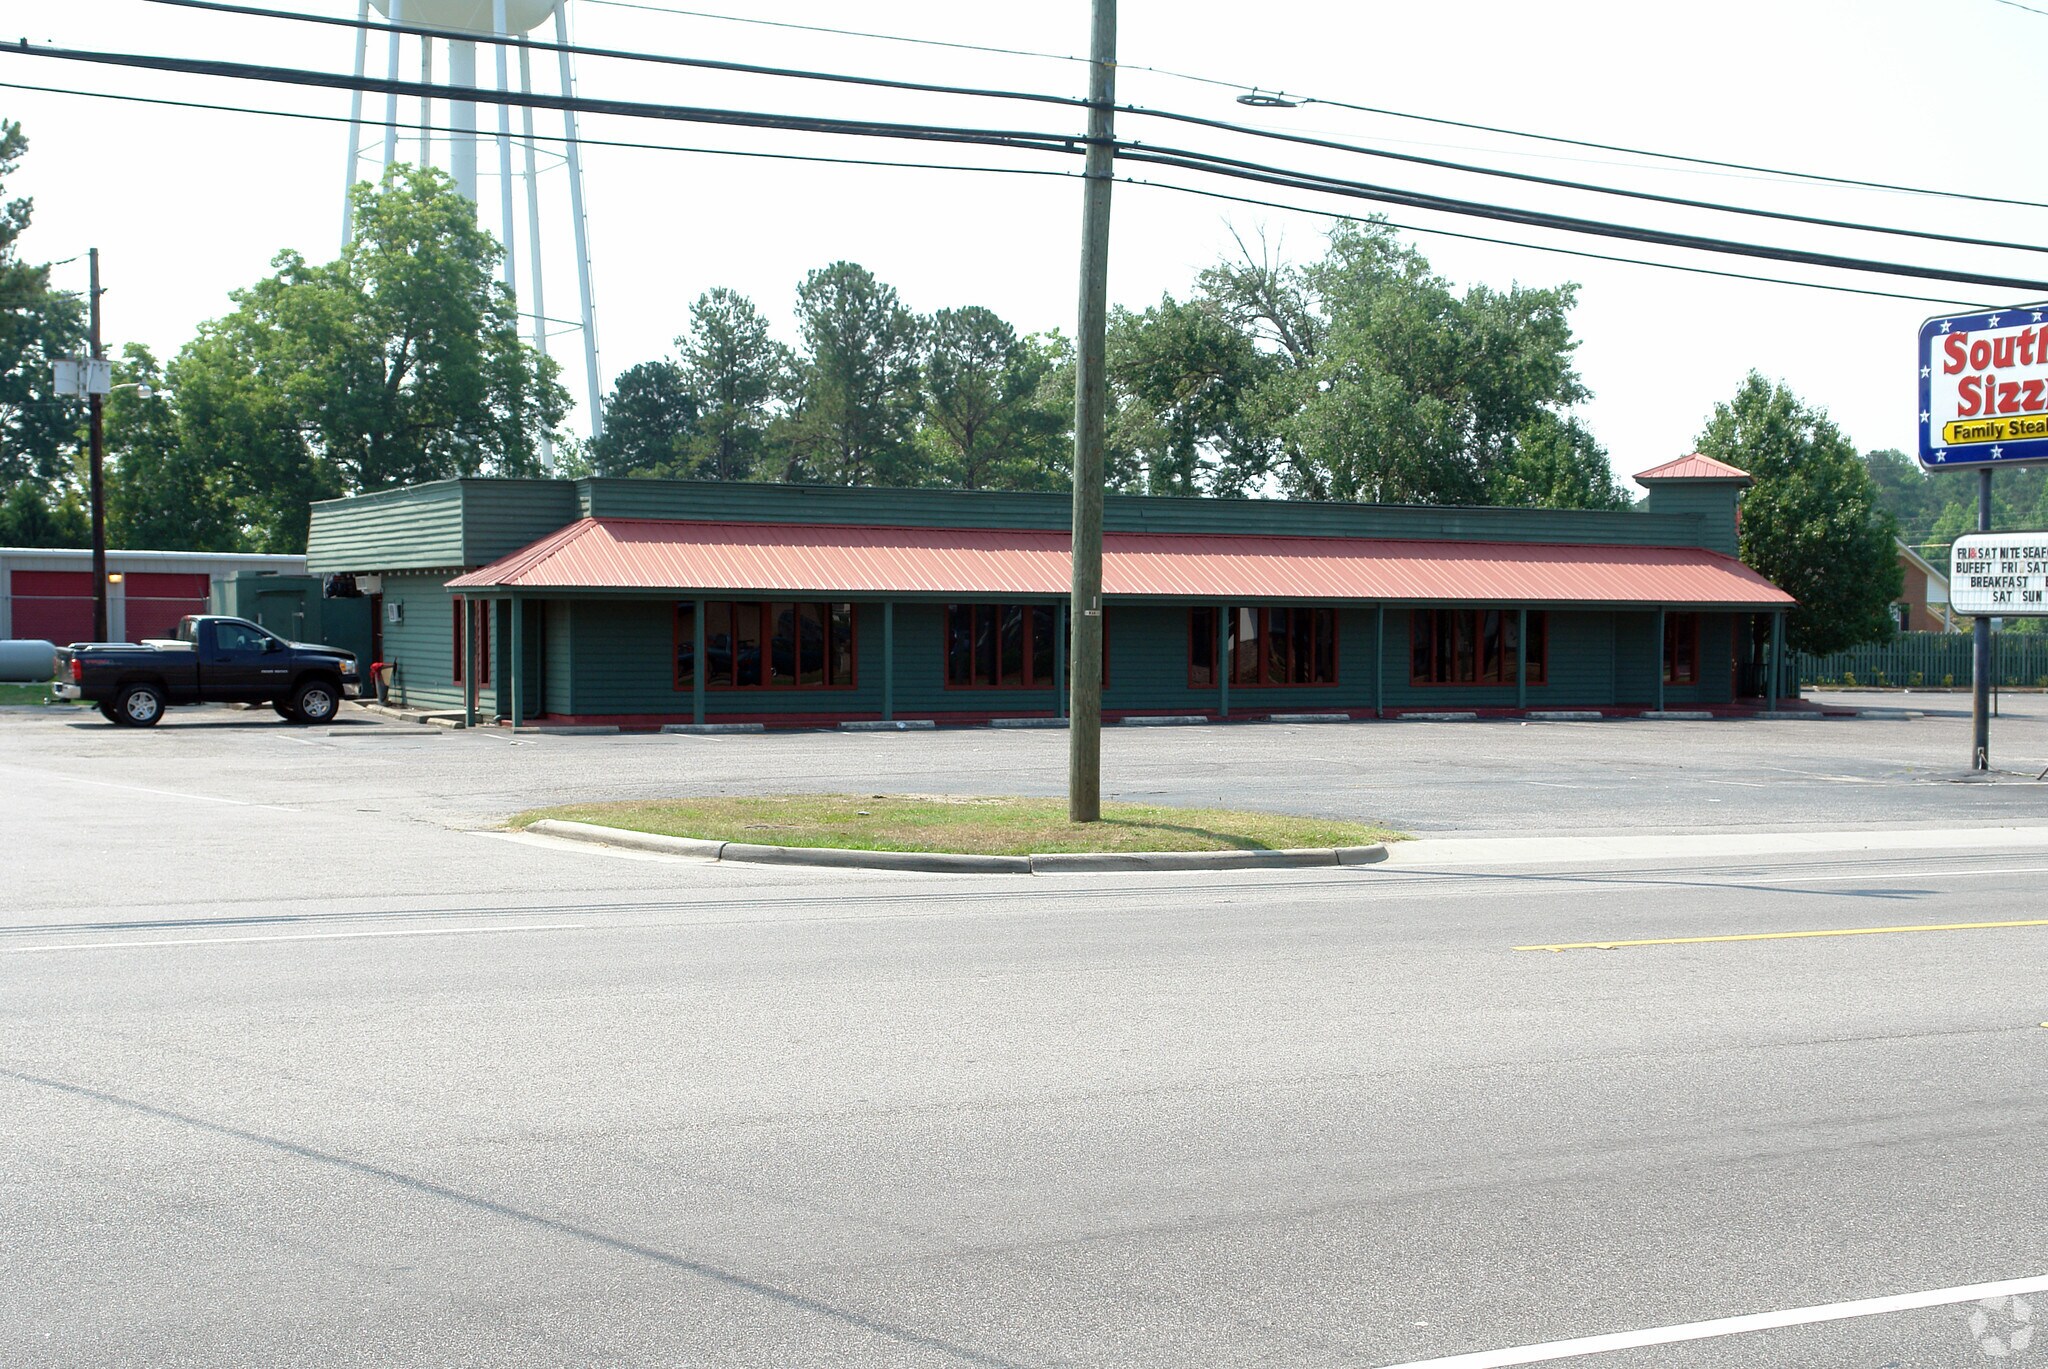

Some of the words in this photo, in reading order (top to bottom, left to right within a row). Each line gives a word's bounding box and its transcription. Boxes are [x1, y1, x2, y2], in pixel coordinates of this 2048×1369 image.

[1958, 374, 2048, 418] Sizz
[1954, 423, 2004, 440] Family
[2009, 418, 2048, 435] Stea
[2000, 547, 2020, 558] NITE
[2023, 547, 2048, 558] SEAF
[2002, 561, 2018, 573] FRI
[2027, 561, 2048, 573] SAT
[1971, 576, 2028, 588] BREAKFAST
[1993, 591, 2012, 602] SAT
[2022, 590, 2042, 602] SUN
